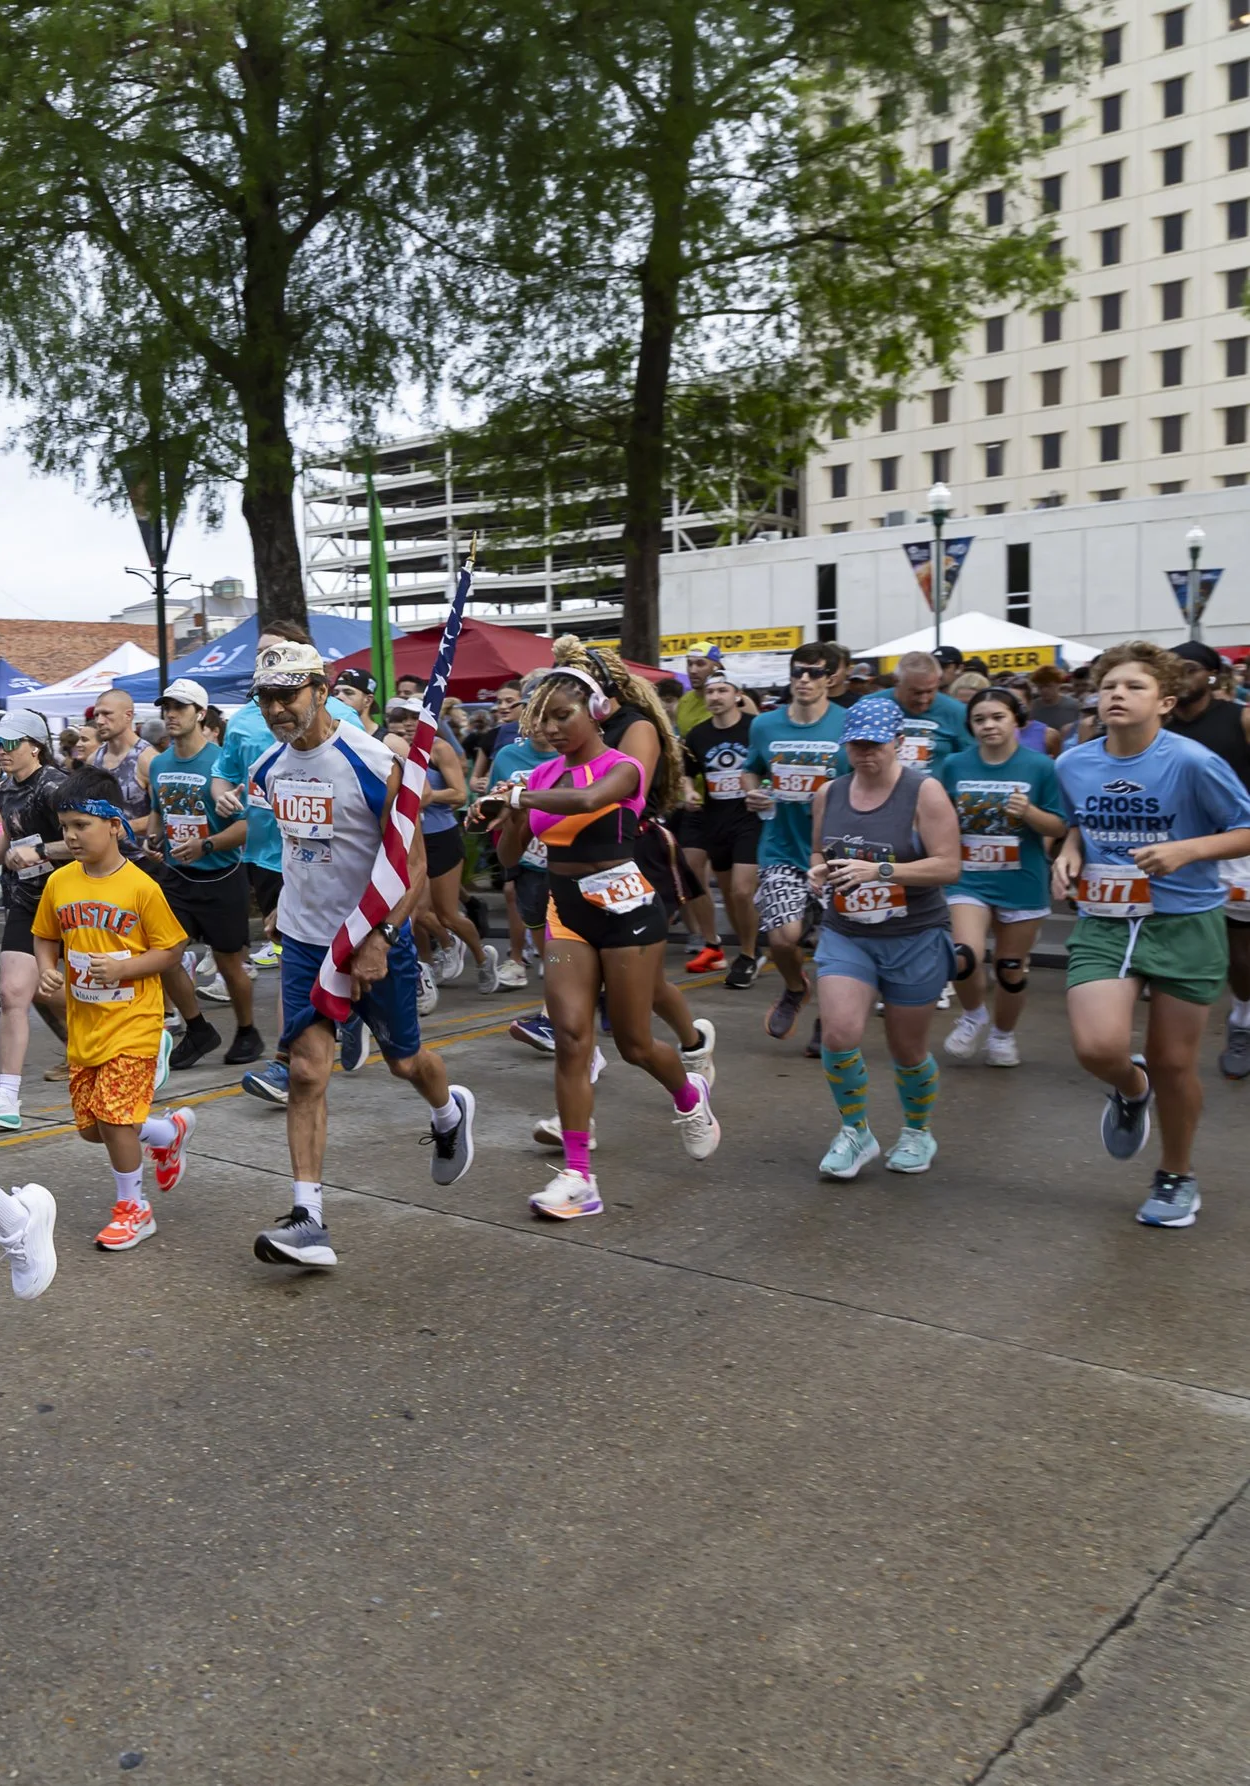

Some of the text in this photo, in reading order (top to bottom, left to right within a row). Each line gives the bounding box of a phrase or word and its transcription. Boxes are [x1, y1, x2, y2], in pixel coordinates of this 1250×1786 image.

[989, 652, 1040, 669] BEER
[779, 775, 815, 792] 587
[277, 796, 327, 823] 1065
[1085, 796, 1160, 814] CROSS
[1075, 812, 1178, 832] COUNTRY
[172, 825, 200, 841] 353
[969, 847, 1006, 862] 501
[845, 887, 892, 912] 832
[1086, 879, 1134, 902] 877
[57, 901, 139, 937] HUSTLE
